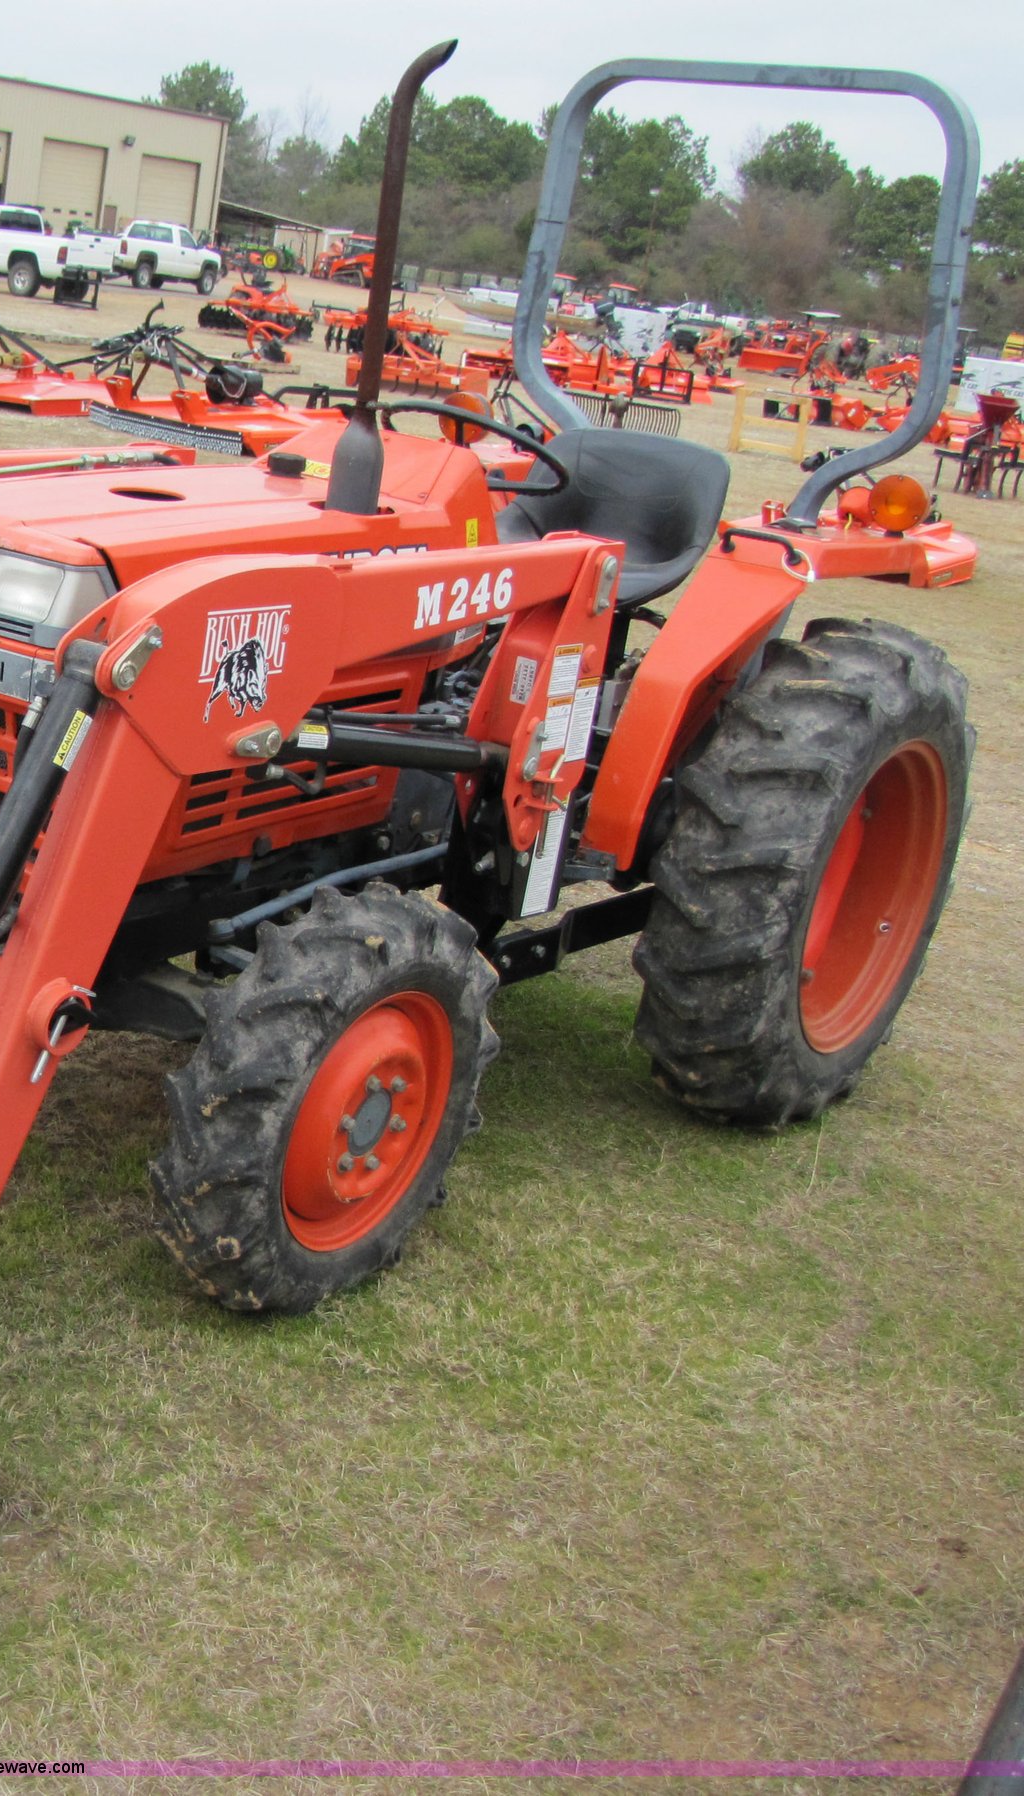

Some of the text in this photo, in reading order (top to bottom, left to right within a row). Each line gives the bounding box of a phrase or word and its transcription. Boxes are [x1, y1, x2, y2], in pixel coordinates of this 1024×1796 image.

[413, 567, 513, 631] M 246
[199, 611, 253, 677] BUSH
[61, 716, 82, 751] CAUTION
